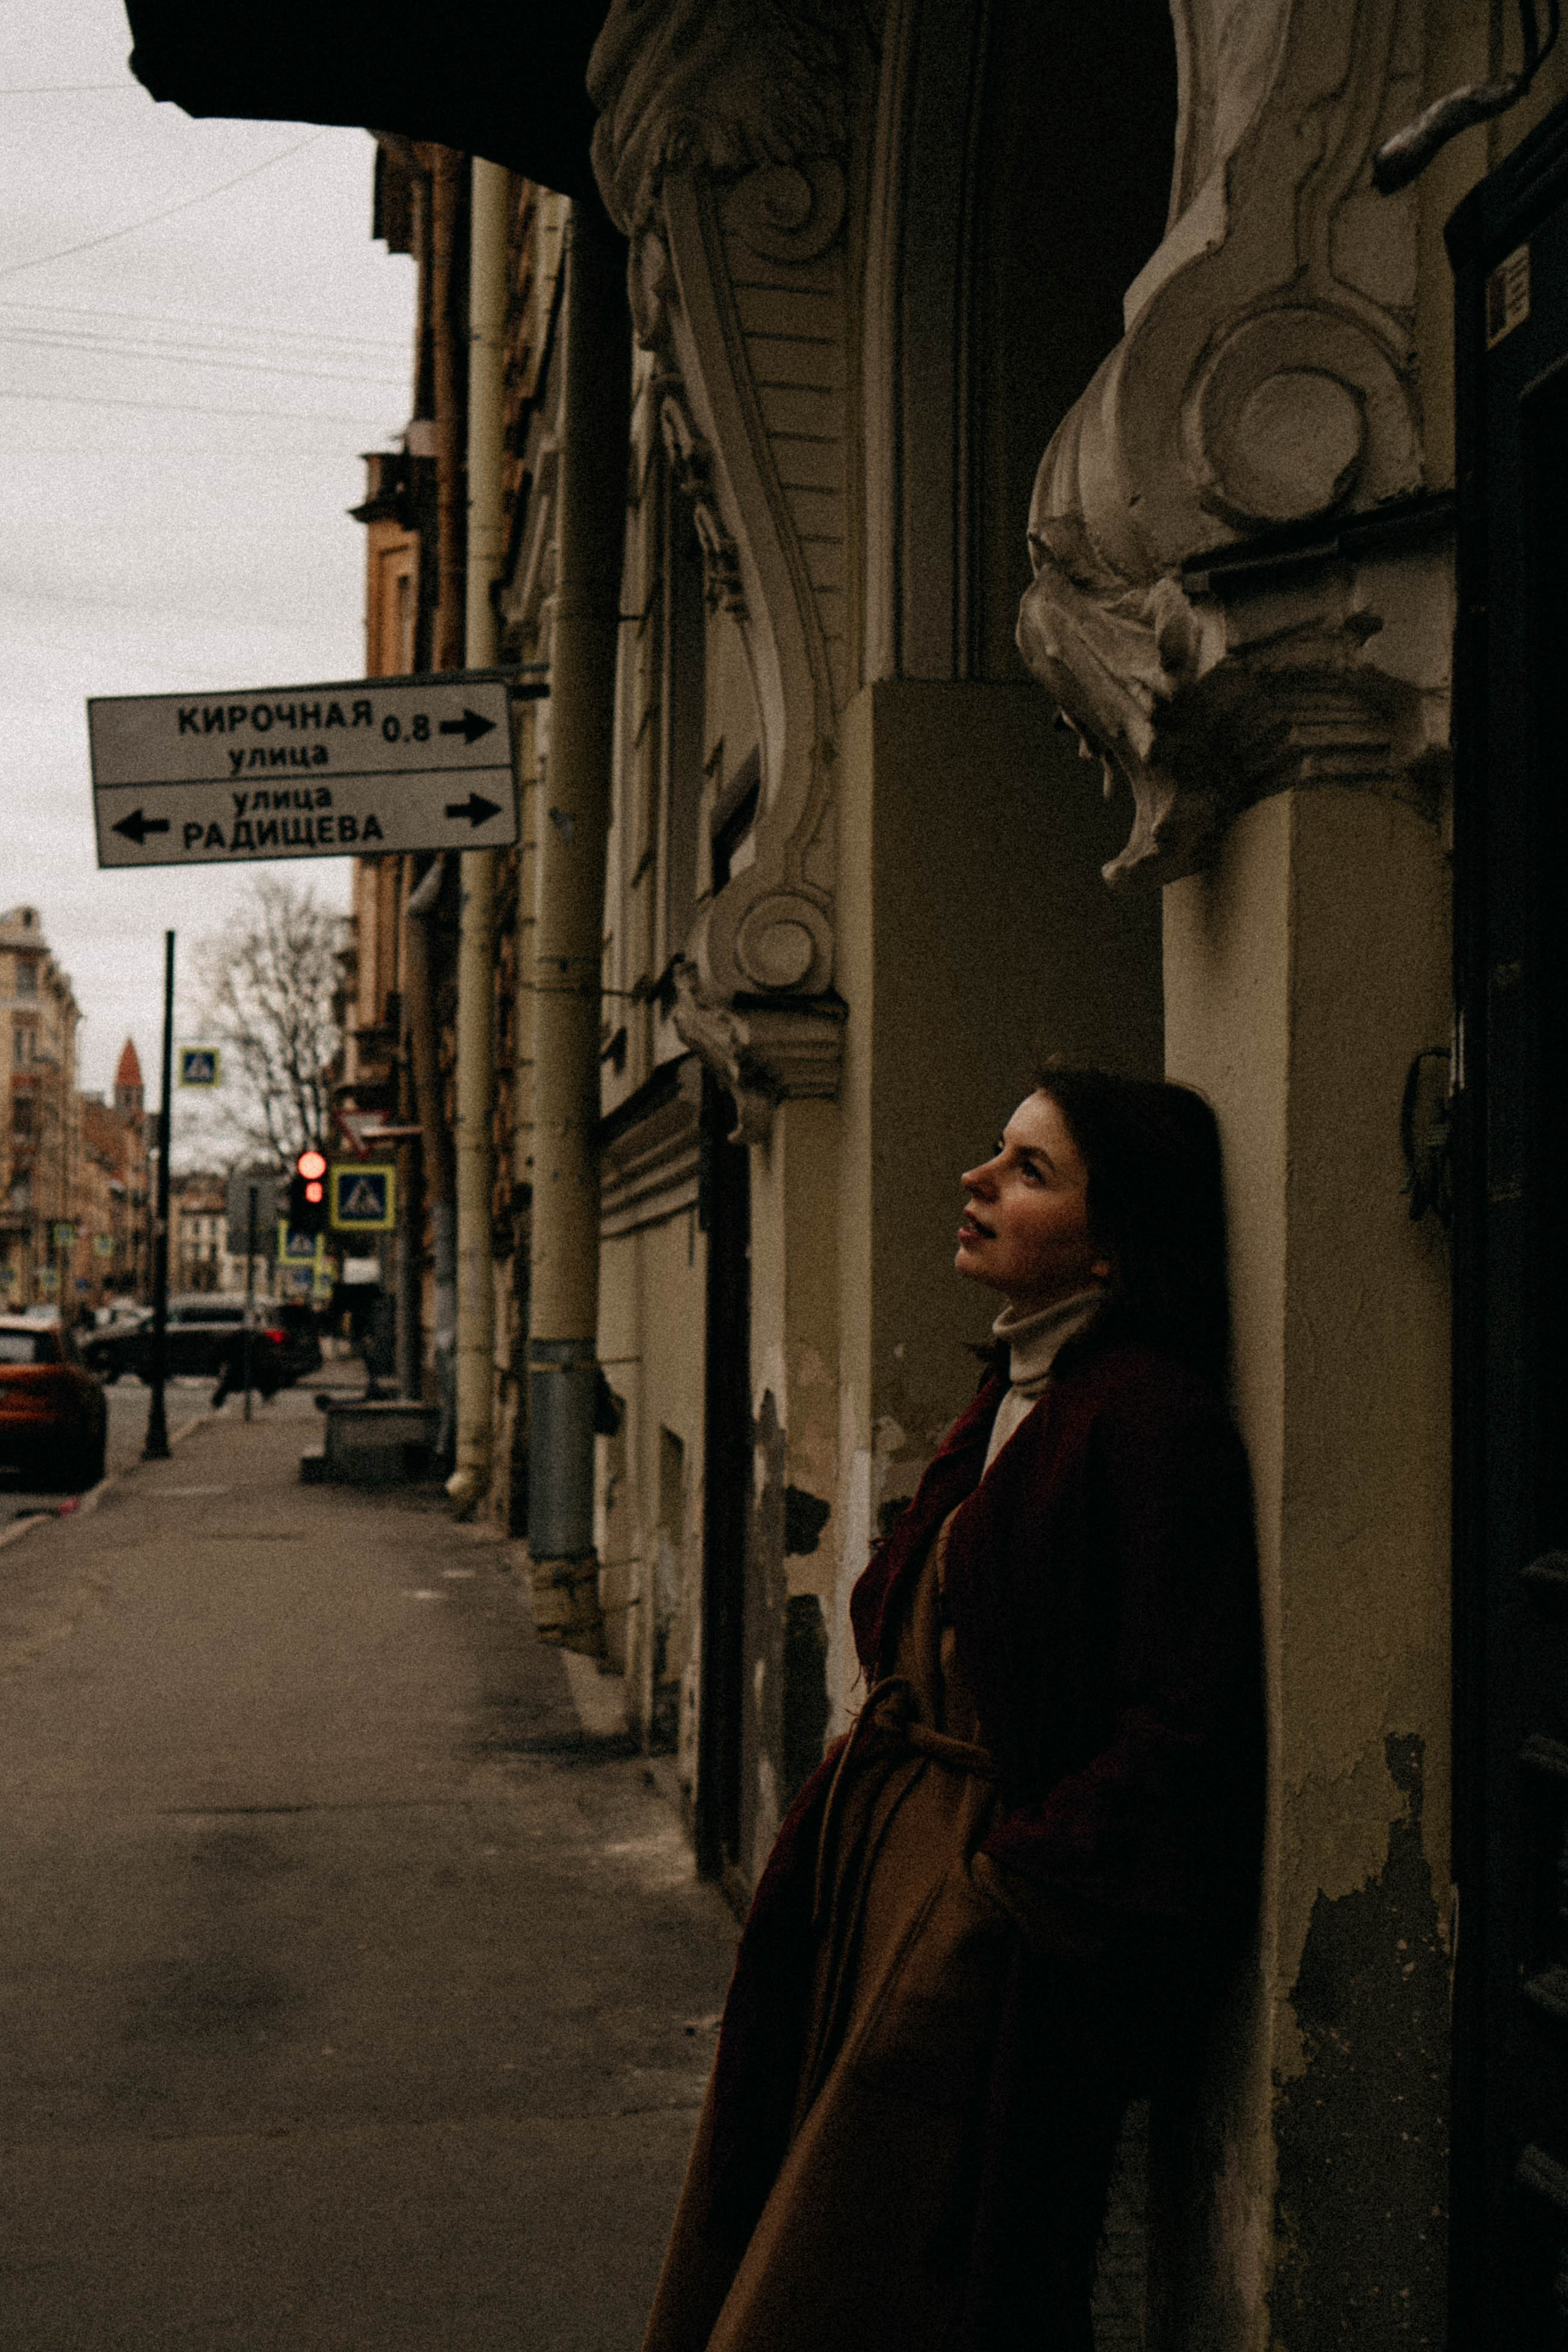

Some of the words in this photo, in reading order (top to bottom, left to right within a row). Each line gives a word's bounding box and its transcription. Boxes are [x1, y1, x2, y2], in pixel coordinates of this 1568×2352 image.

[178, 700, 374, 734] КИРОЧНАЯ
[229, 744, 329, 775] улица
[232, 786, 333, 816] улица
[184, 814, 383, 851] РАДИЩЕВА
